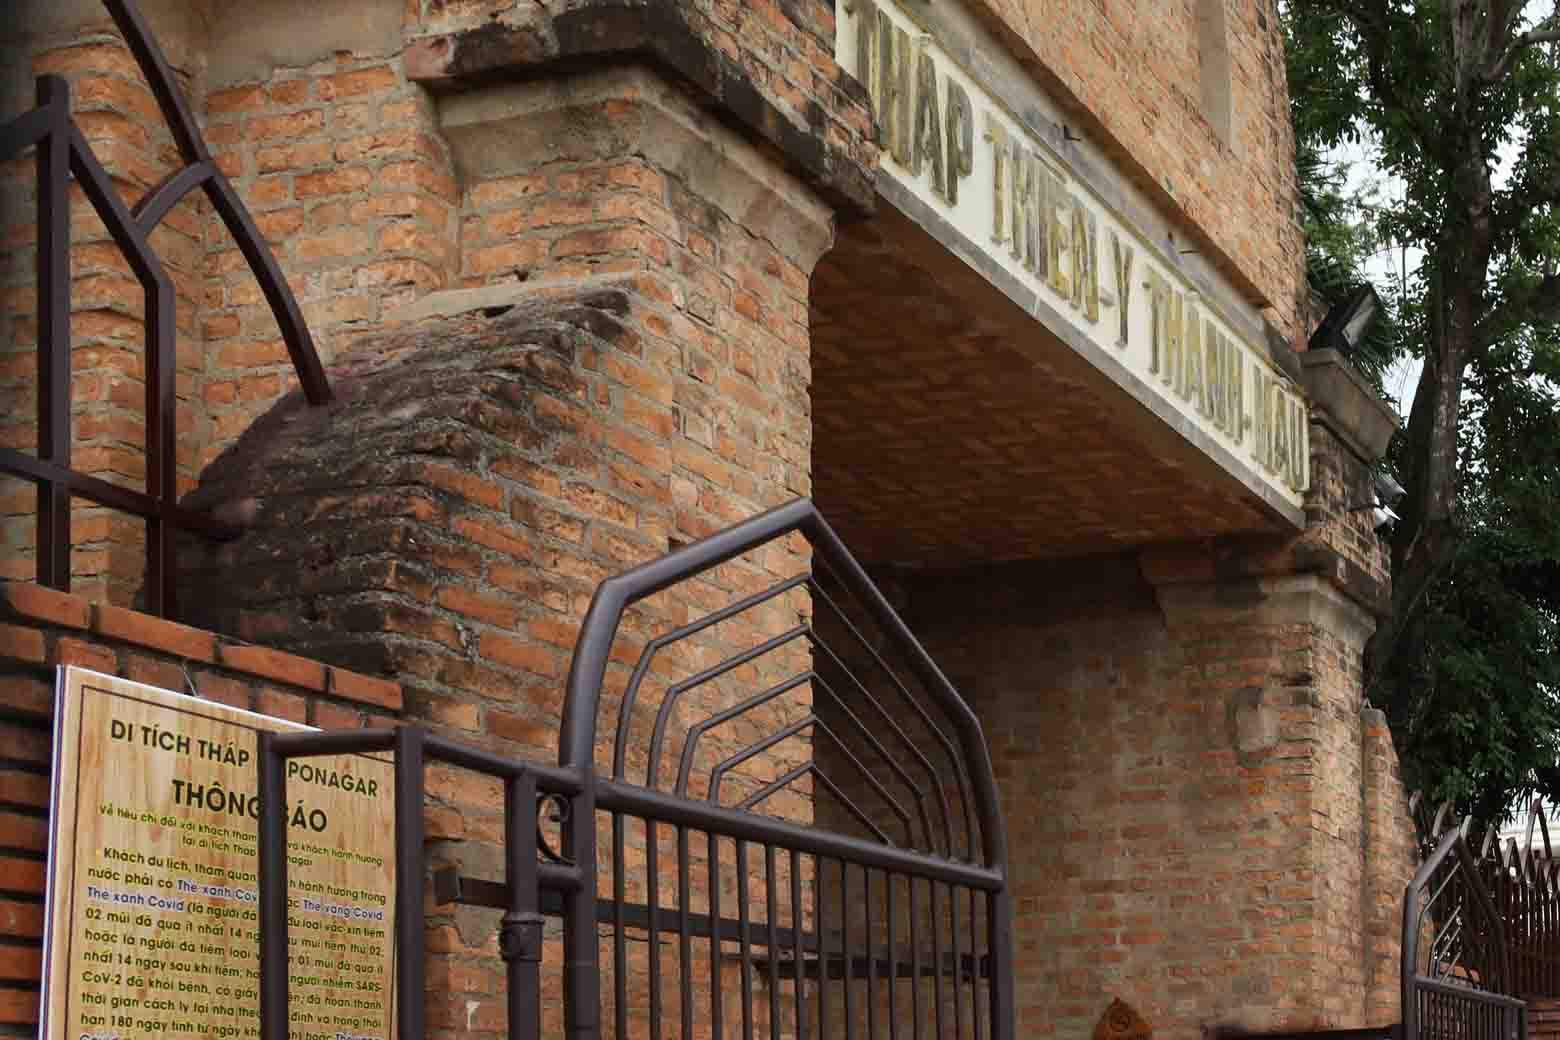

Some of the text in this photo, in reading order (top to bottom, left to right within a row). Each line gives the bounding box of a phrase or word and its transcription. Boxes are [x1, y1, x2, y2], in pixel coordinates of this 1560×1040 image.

[111, 718, 377, 797] DI TÍCH THÁP PONAGAR
[171, 777, 262, 819] THÔNG
